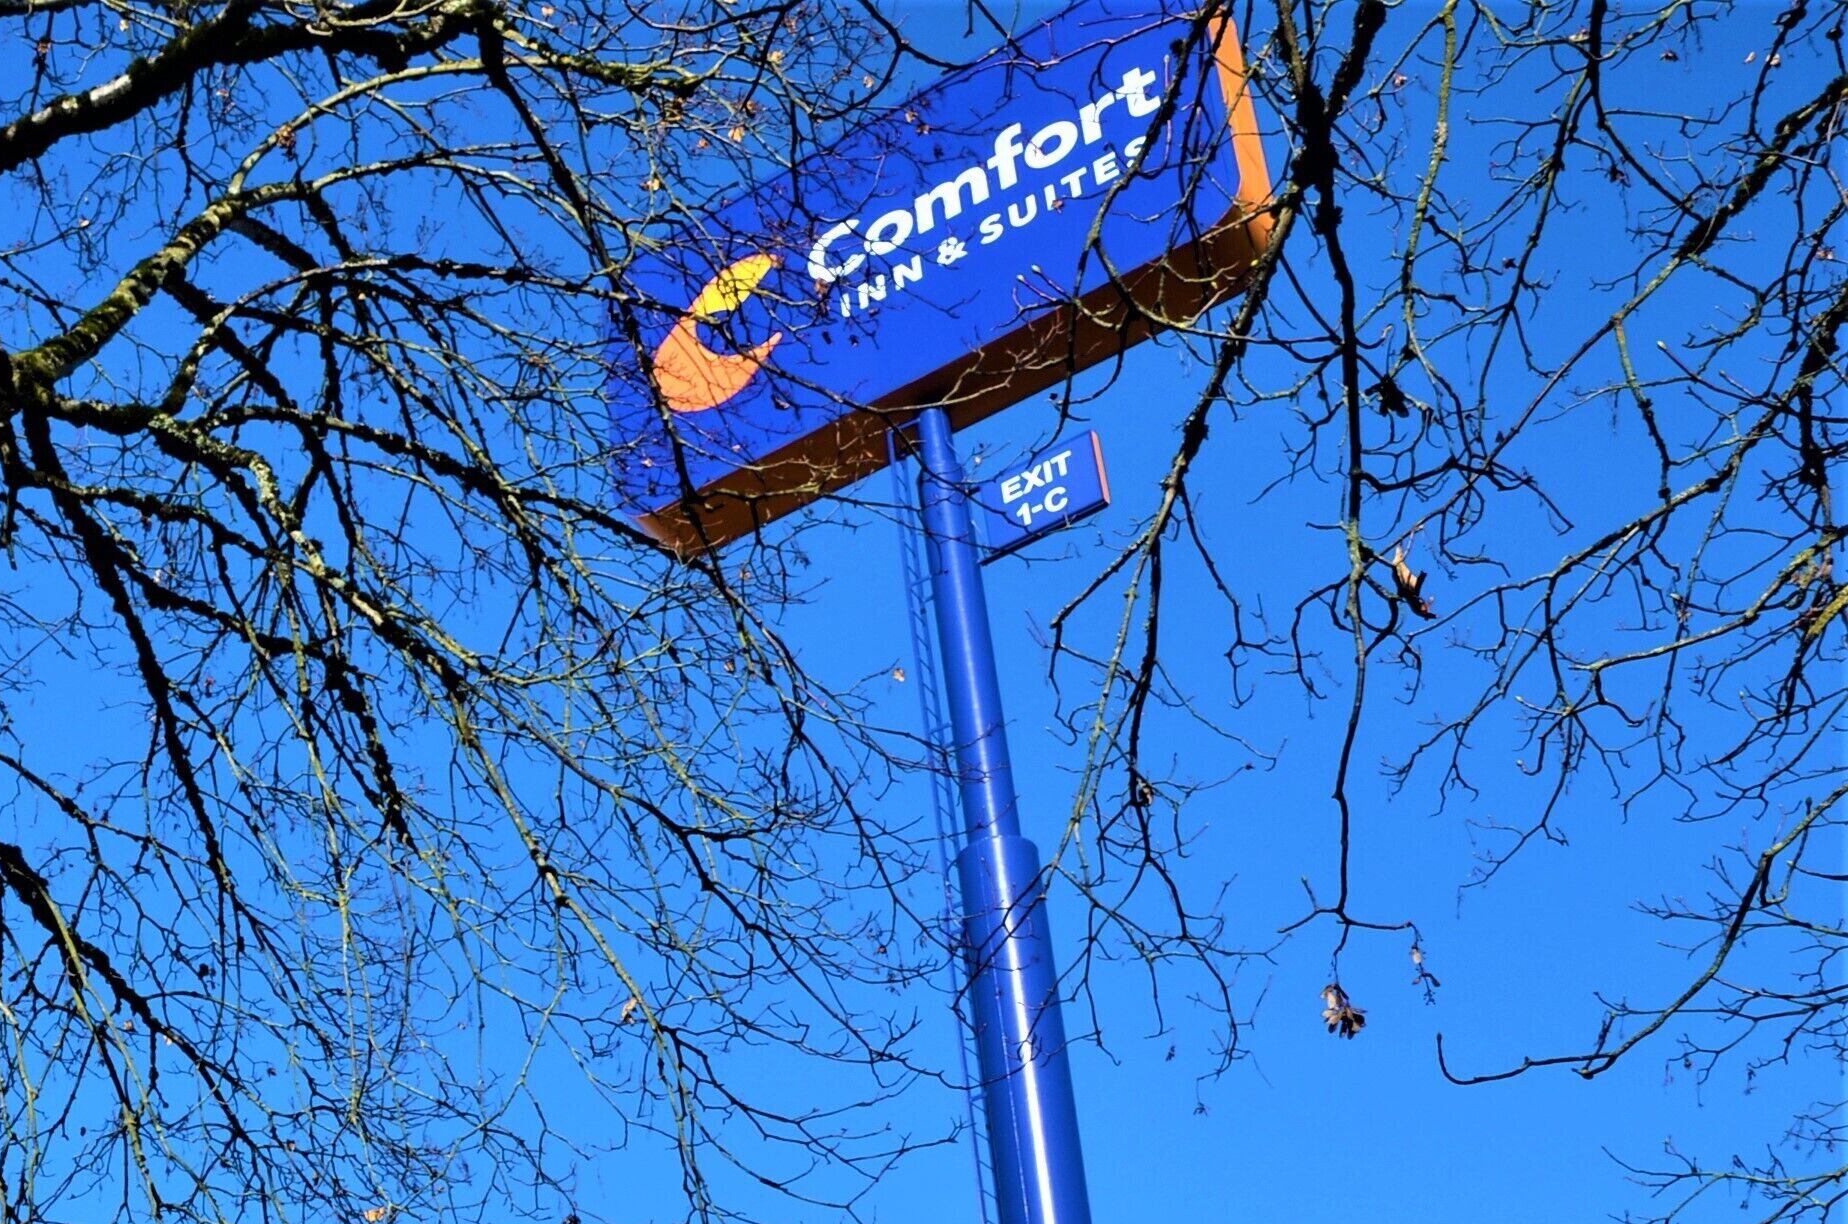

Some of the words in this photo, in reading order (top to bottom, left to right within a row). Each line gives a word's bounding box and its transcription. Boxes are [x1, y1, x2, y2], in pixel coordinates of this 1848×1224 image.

[807, 67, 1161, 283] Comfort
[840, 255, 923, 318] INN
[936, 236, 968, 266] &
[979, 135, 1152, 245] SUITES
[1000, 450, 1072, 504] EXIT
[1016, 486, 1068, 526] 1-C
